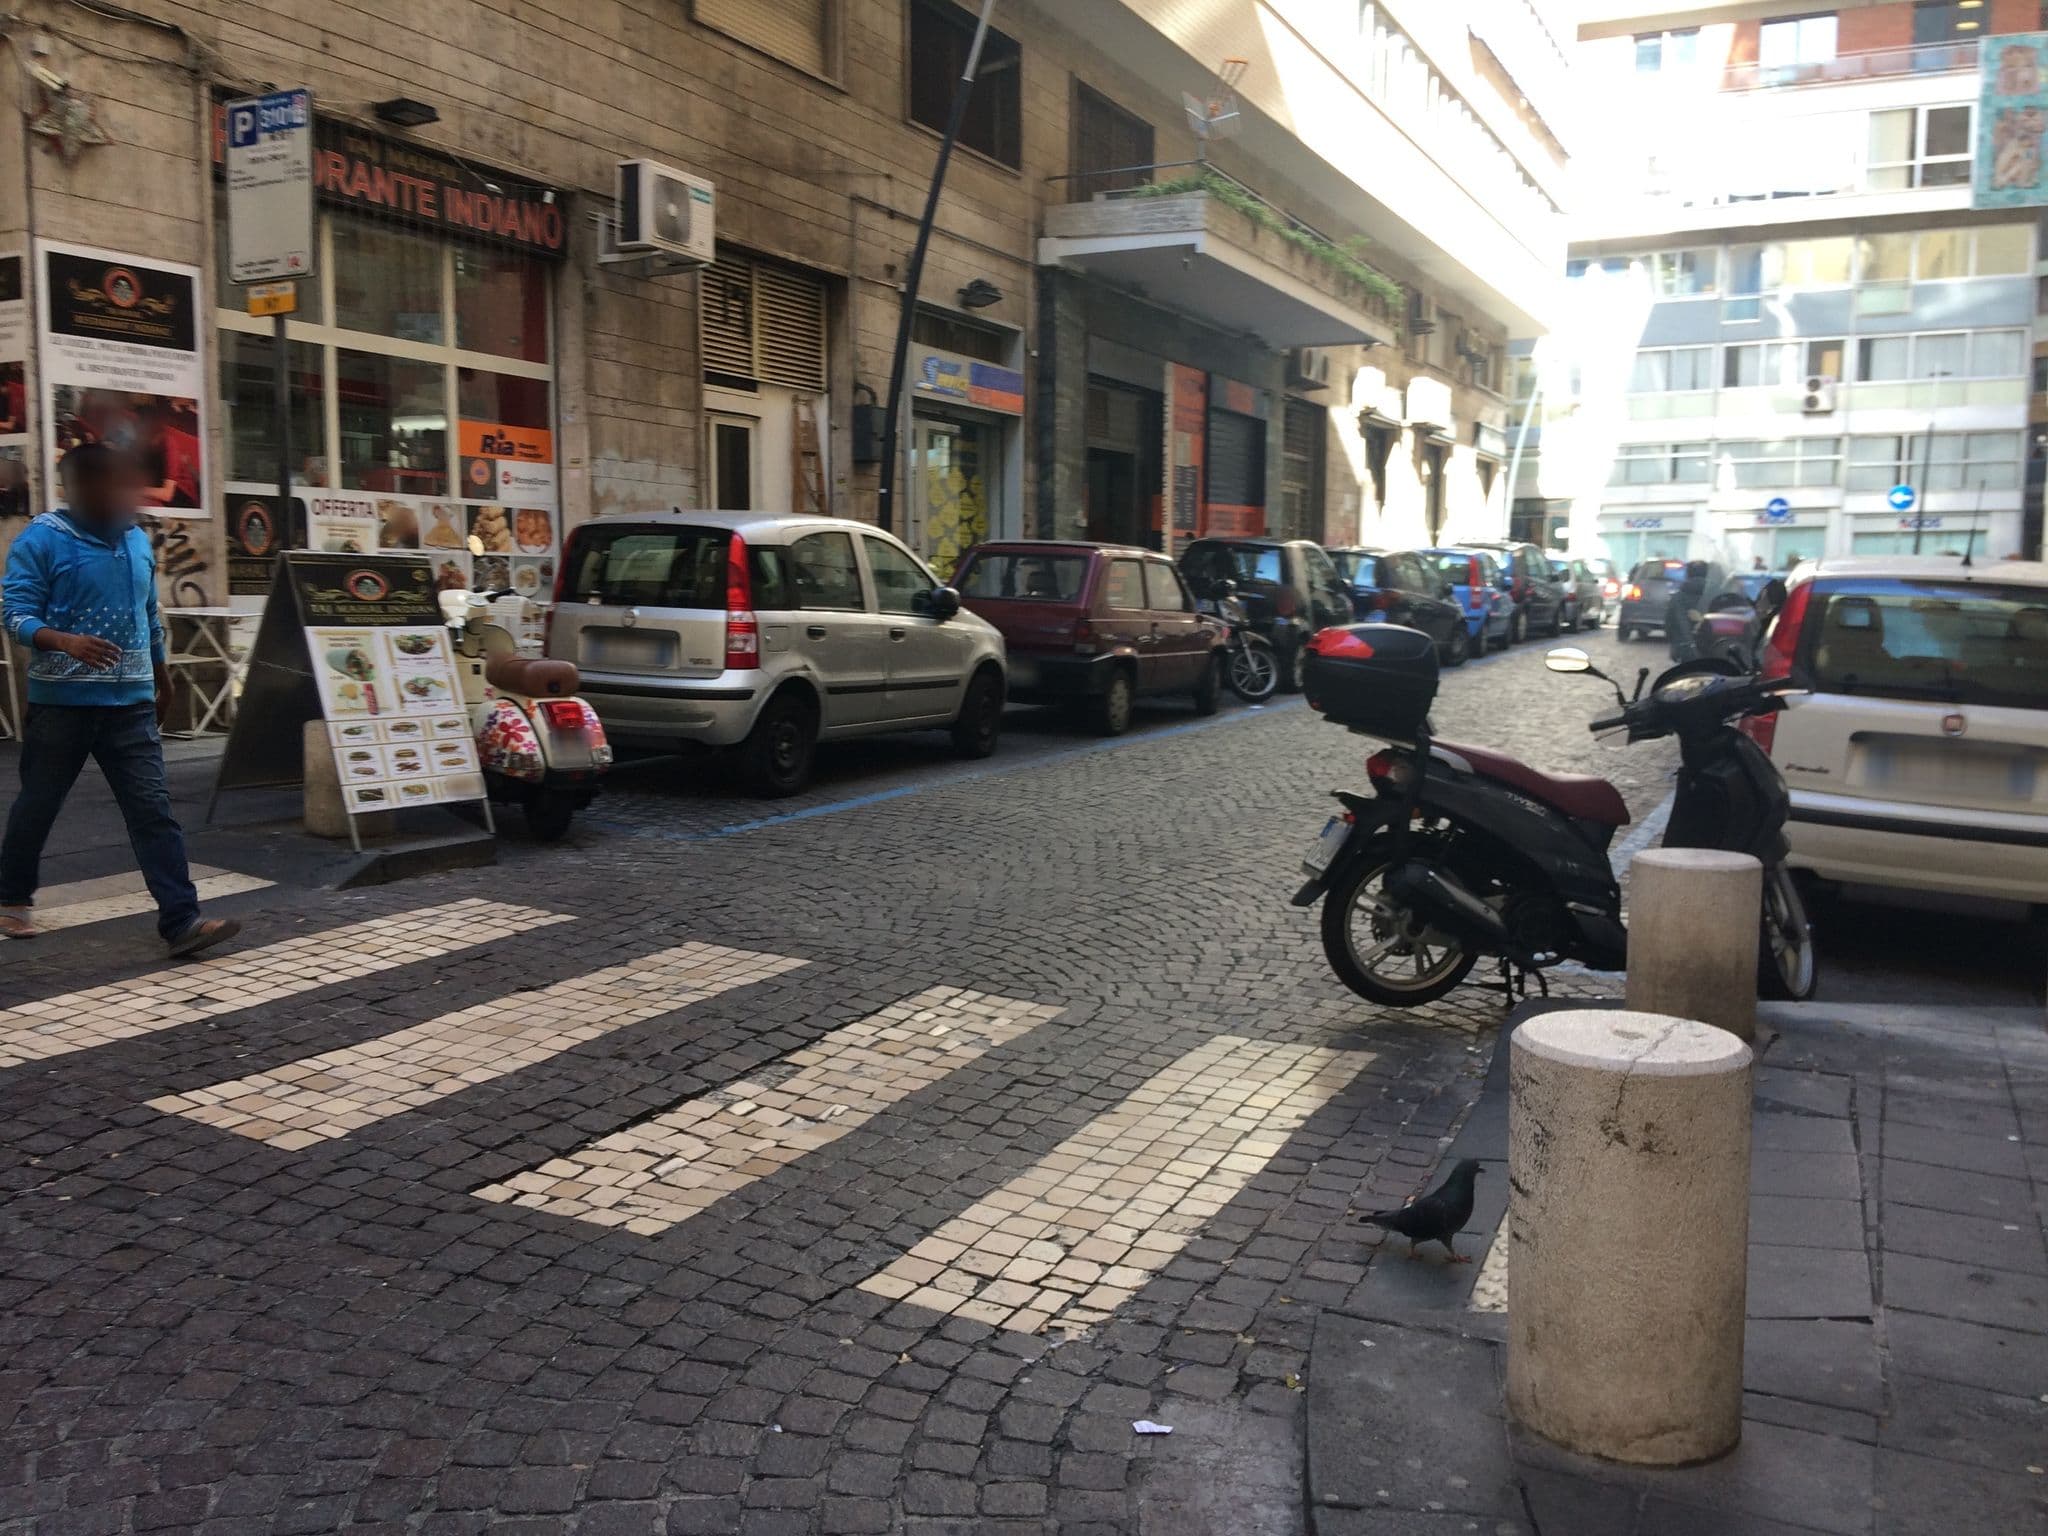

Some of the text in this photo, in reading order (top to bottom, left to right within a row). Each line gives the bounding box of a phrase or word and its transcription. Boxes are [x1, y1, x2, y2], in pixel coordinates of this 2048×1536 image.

[234, 111, 255, 144] P
[443, 185, 563, 249] INDIANO
[481, 428, 515, 456] Ria
[311, 498, 376, 519] OFFERTA
